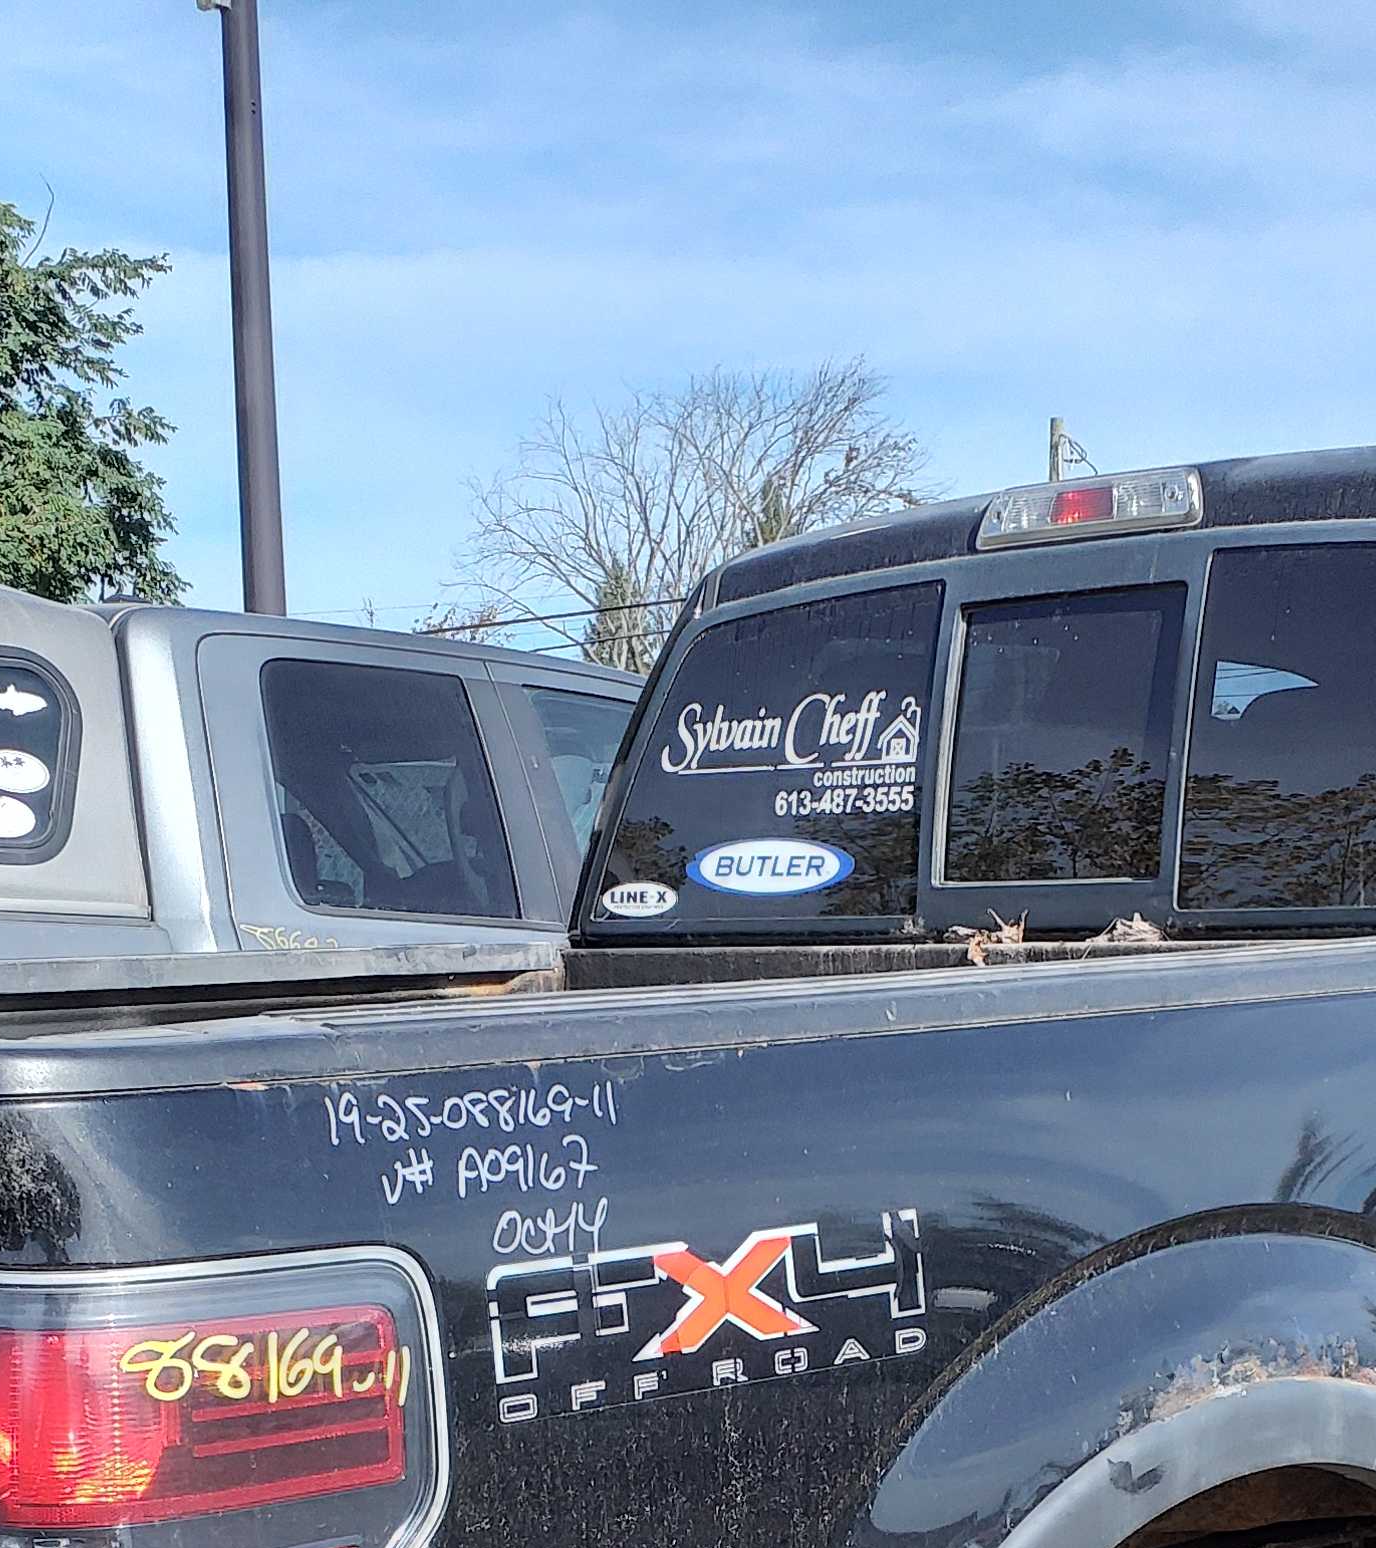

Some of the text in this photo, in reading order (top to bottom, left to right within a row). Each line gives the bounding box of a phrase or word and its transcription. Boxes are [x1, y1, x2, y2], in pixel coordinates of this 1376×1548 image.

[661, 689, 887, 773] Sylvain Cheff
[775, 785, 915, 816] 613-487-3555
[813, 766, 916, 788] construction
[715, 855, 825, 877] BUTLER
[323, 1080, 617, 1147] 19-25-088169-11
[458, 1134, 600, 1199] A09167
[487, 1207, 926, 1385] FX4
[499, 1327, 927, 1424] OFF ROAD
